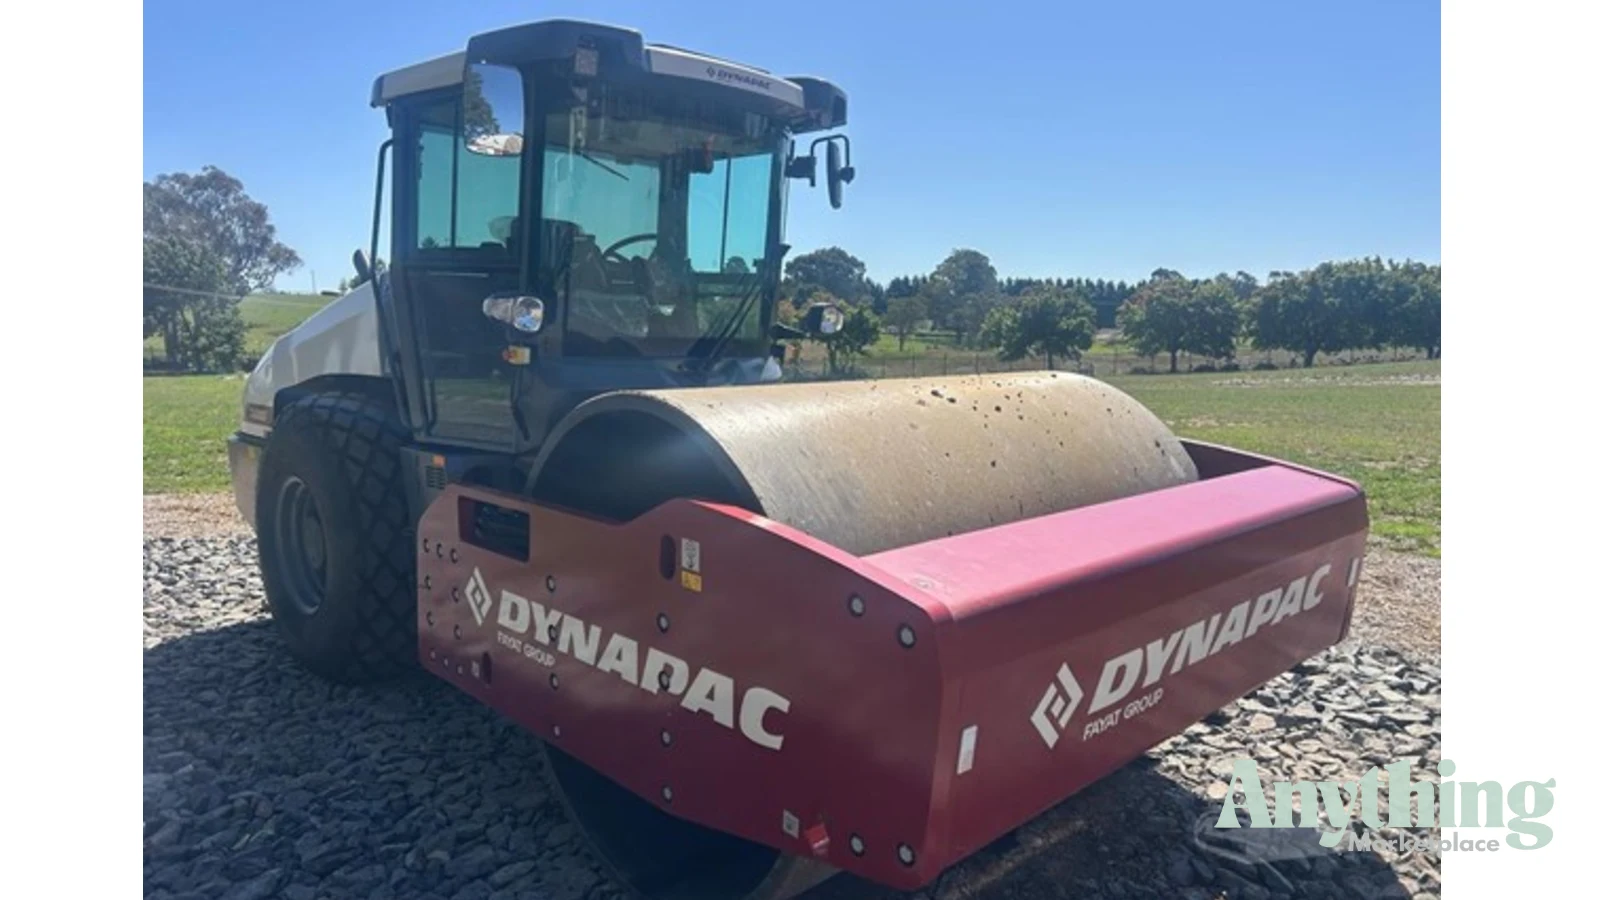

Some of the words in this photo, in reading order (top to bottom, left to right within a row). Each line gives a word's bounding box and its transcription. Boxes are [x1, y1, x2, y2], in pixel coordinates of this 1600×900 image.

[497, 630, 523, 654] FAYAT
[523, 643, 557, 668] GROUP
[497, 589, 791, 750] DYNAPAC
[1087, 564, 1332, 715] DYNAPAC
[1083, 708, 1122, 741] FAYAT
[1123, 687, 1164, 719] GROUP
